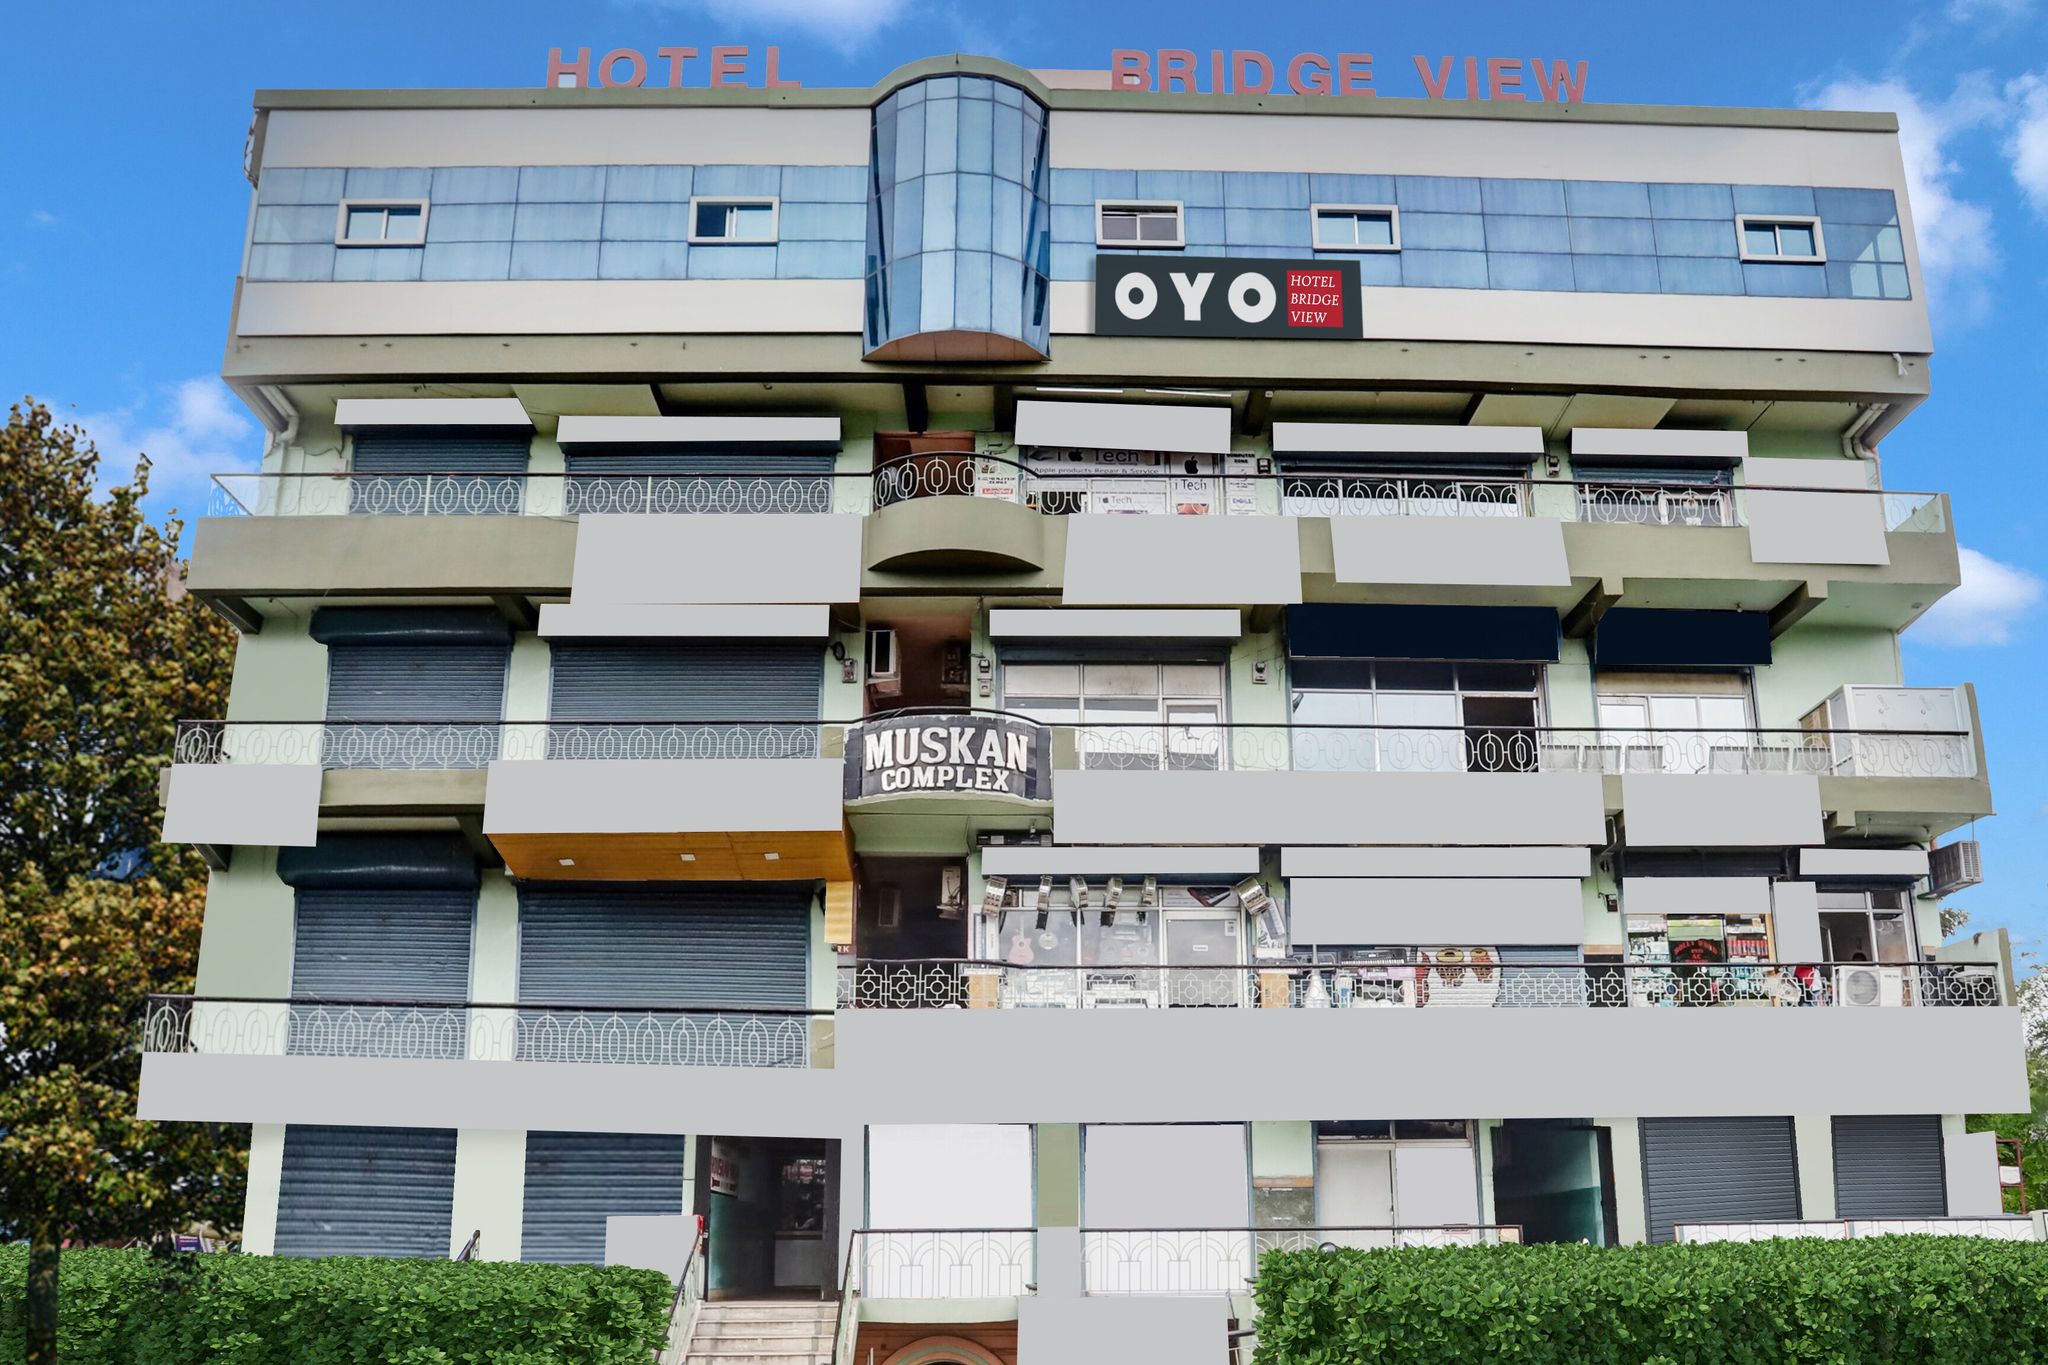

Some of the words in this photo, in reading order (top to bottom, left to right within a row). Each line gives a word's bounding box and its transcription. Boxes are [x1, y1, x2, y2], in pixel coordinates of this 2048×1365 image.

[546, 46, 802, 89] HOTEL
[1111, 49, 1377, 97] BRIDGE
[1413, 56, 1590, 104] VIEW
[1291, 275, 1336, 288] HOTEL
[1115, 272, 1277, 323] OYO
[1291, 293, 1340, 306] BRIDGE
[1291, 311, 1328, 323] VIEW
[1095, 450, 1139, 462] Tech
[1034, 467, 1056, 475] Apple
[1058, 467, 1092, 475] products
[1094, 467, 1119, 475] Repair
[1130, 467, 1159, 475] Service
[1181, 479, 1207, 490] Tech
[1111, 496, 1132, 504] Tech
[864, 727, 1029, 772] MUSKAN
[881, 766, 1009, 792] COMPLEX
